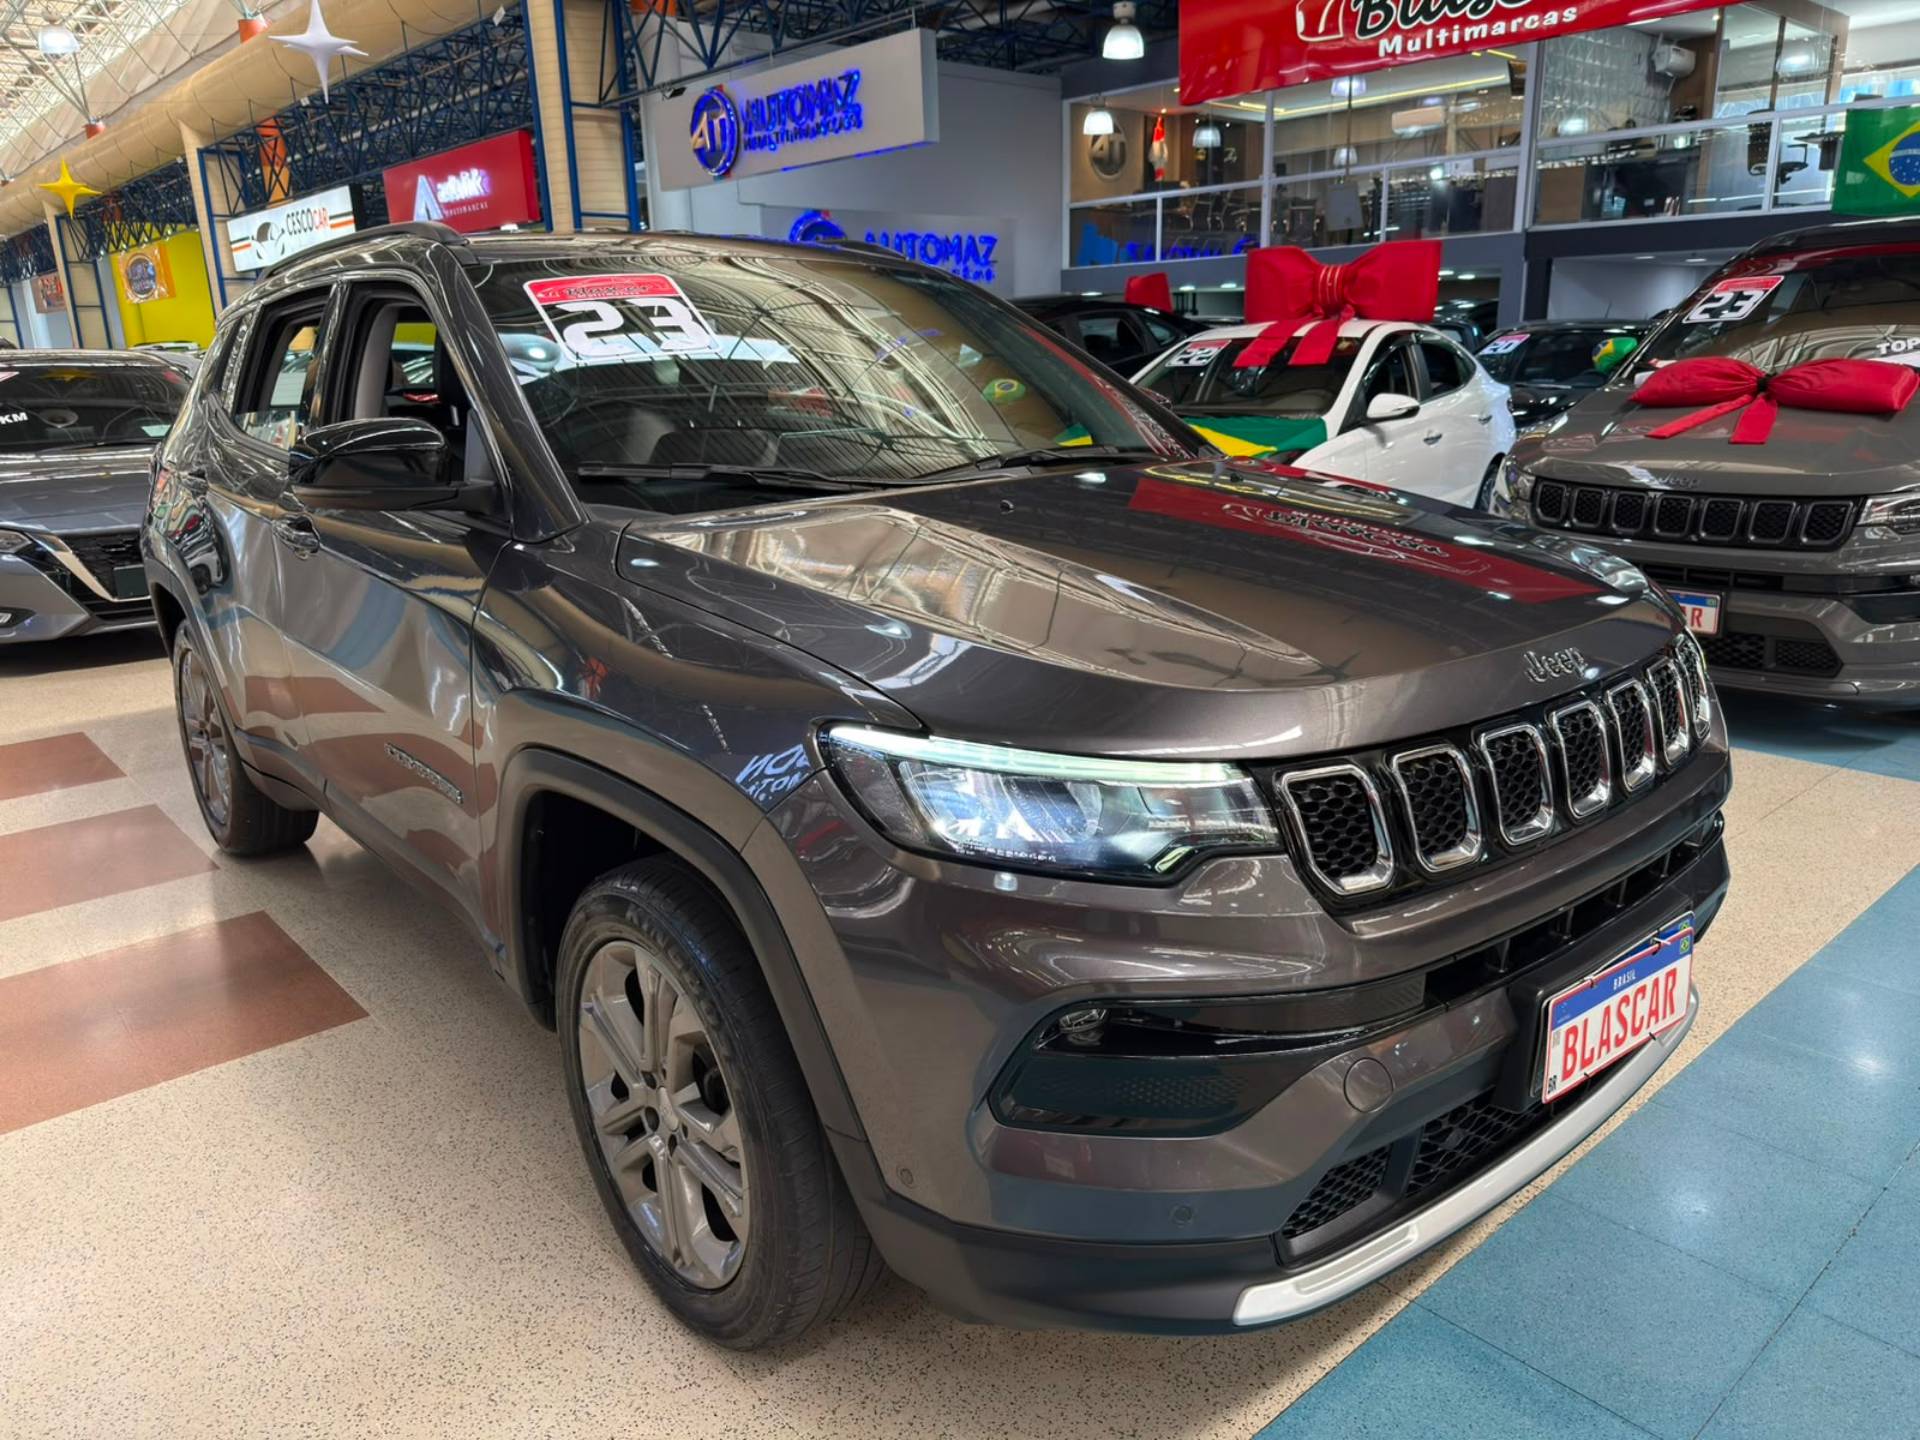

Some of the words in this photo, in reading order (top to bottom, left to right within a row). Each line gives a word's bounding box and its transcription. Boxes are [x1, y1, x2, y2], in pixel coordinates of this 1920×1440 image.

[1378, 5, 1578, 57] Multimarcas
[740, 68, 862, 134] AUTOMAZ
[285, 206, 330, 236] CESCOCAR
[1689, 288, 1765, 321] 23
[555, 297, 711, 357] 23
[1876, 337, 1920, 355] TOP
[1522, 646, 1590, 683] Jeep
[1612, 968, 1637, 991] BRASIL
[1560, 966, 1678, 1082] BLASCAR
